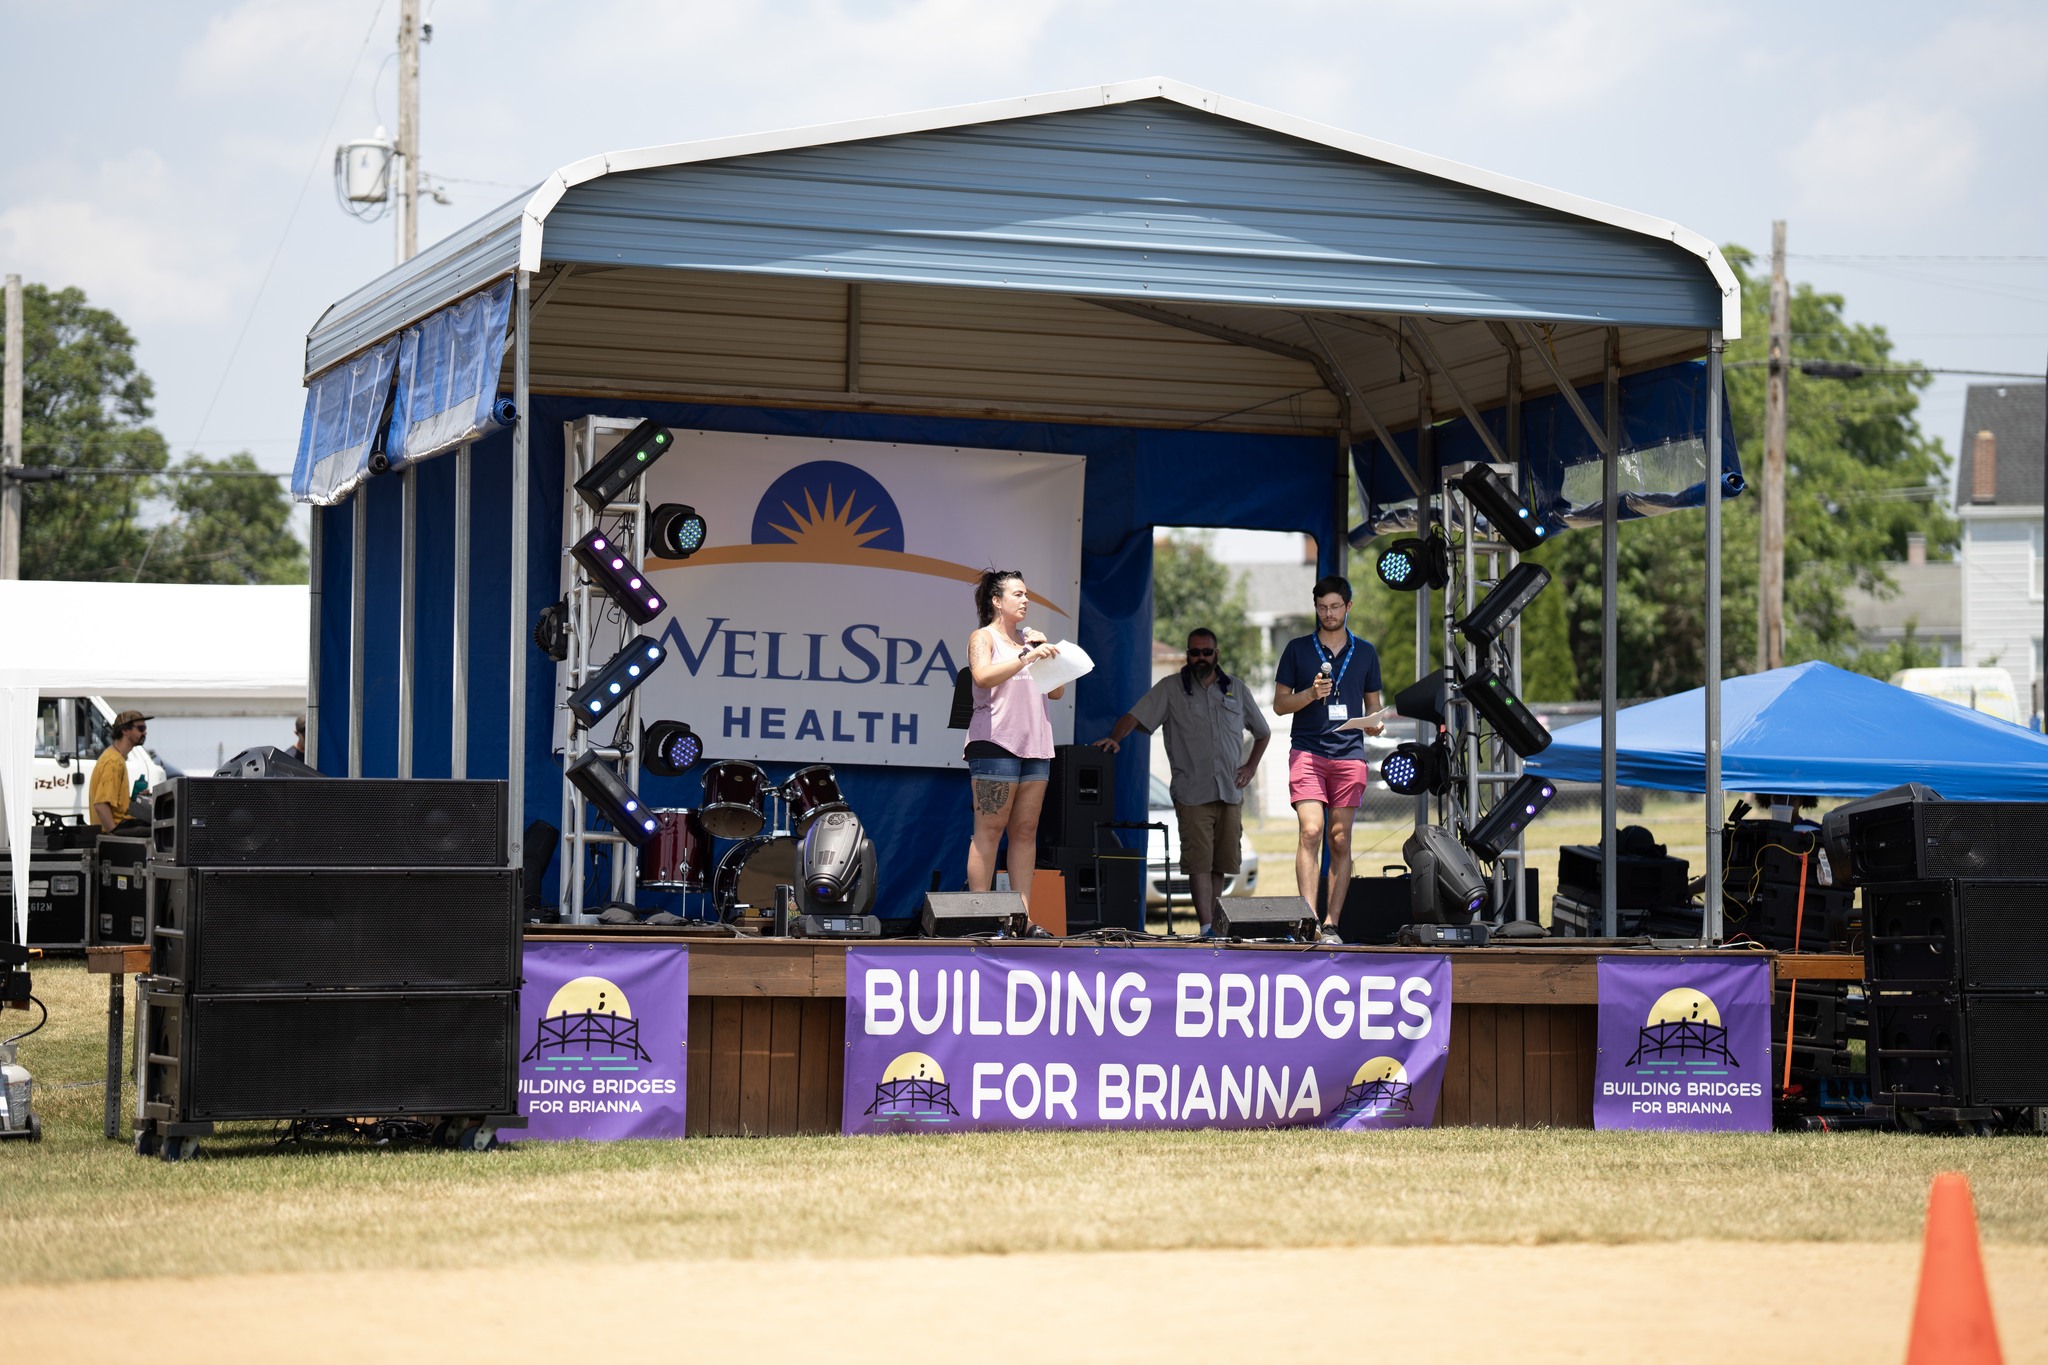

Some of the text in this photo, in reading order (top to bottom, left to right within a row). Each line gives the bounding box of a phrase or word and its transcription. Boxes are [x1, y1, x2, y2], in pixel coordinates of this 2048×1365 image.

[723, 706, 918, 745] HEALTH
[865, 969, 1433, 1040] BUILDING BRIDGES
[592, 1079, 676, 1094] BRIDGES
[972, 1062, 1321, 1120] FOR BRIANNA
[1603, 1081, 1762, 1096] BUILDING BRIDGES
[530, 1100, 642, 1113] FOR BRIANNA
[1632, 1101, 1732, 1114] FOR BRIANNA
